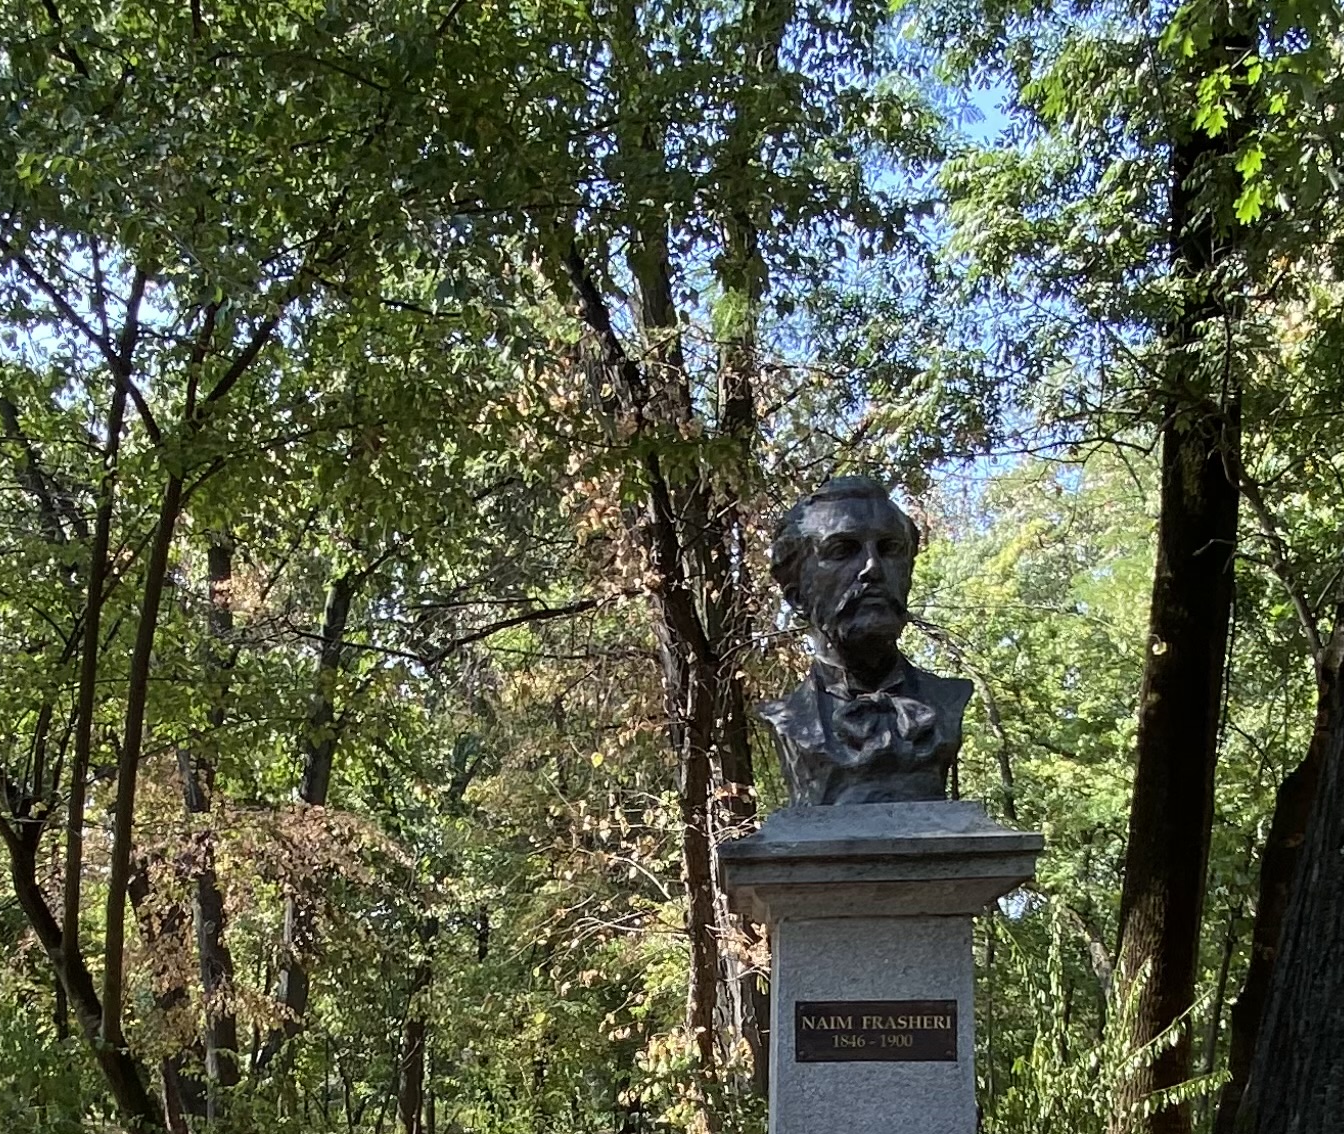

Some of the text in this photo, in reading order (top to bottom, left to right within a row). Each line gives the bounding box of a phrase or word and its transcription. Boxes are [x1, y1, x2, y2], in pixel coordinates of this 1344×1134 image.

[801, 1015, 951, 1030] NAIM FRASHERI
[832, 1034, 866, 1048] 1846
[880, 1034, 913, 1048] 1900
